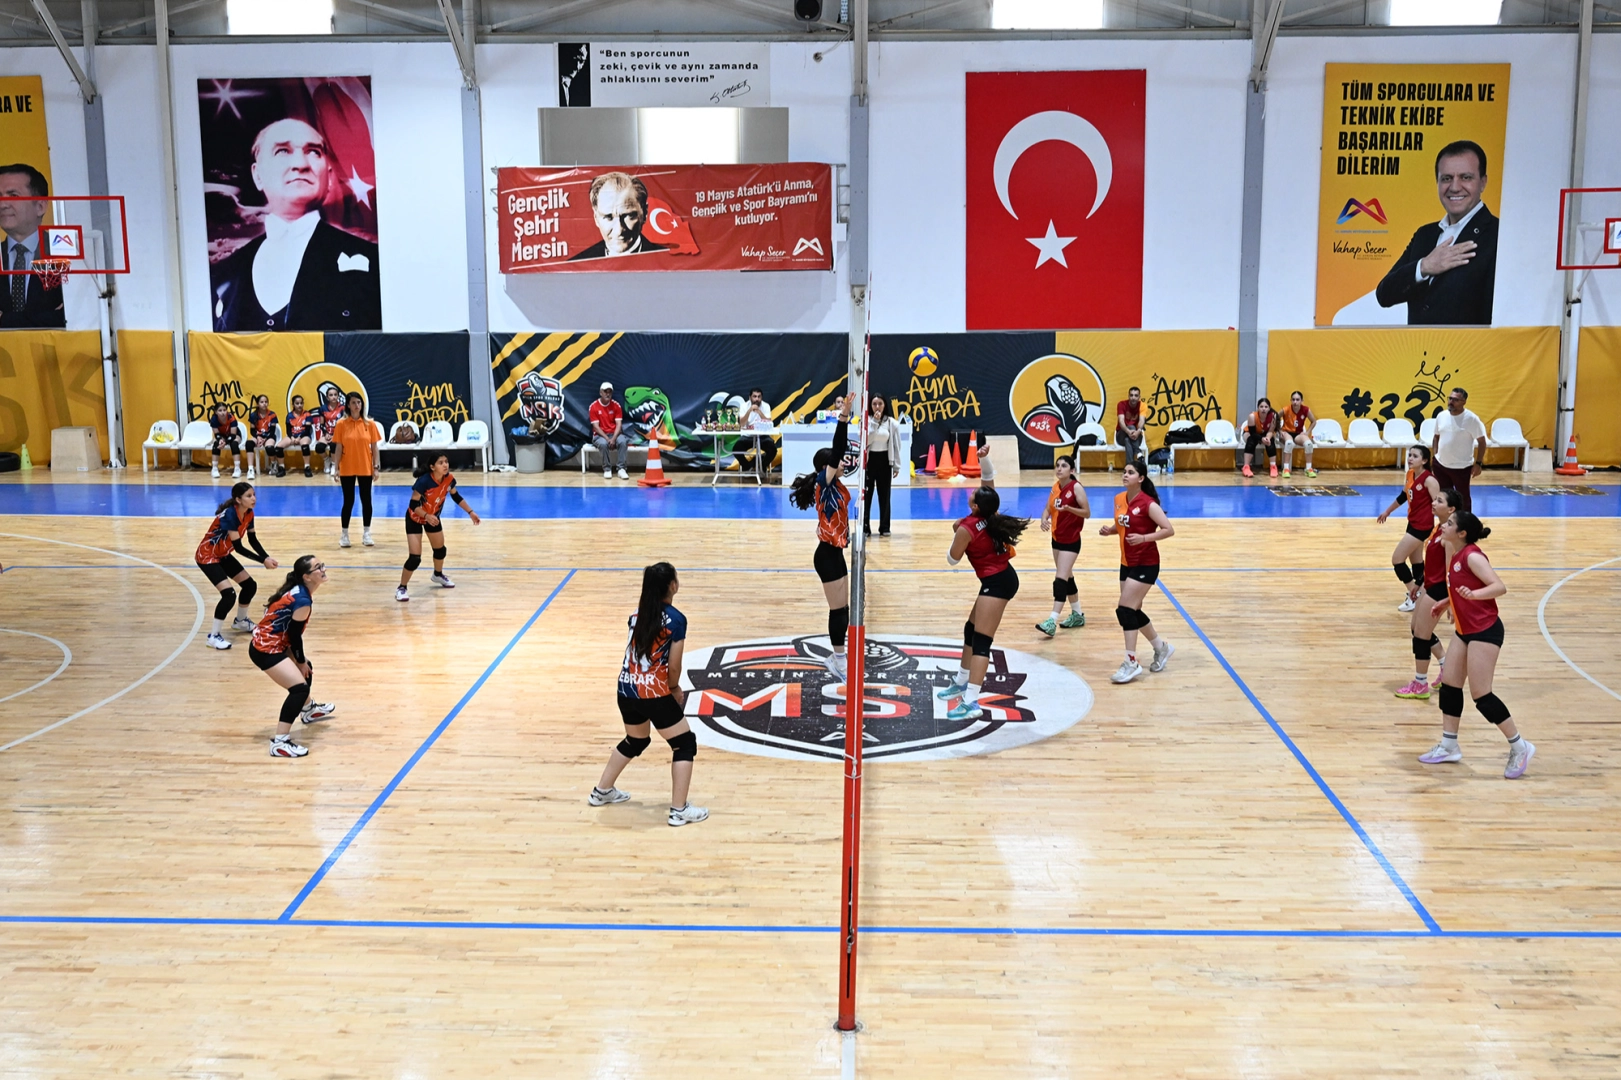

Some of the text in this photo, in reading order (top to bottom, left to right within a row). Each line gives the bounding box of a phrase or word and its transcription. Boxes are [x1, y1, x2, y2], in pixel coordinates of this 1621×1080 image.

[630, 50, 690, 59] sporcunun
[600, 63, 627, 72] zeki,
[631, 63, 661, 72] çevik
[681, 64, 704, 72] aynı
[709, 62, 759, 70] zamanda
[600, 75, 661, 83] ahlaklısını
[1341, 80, 1495, 102] TÜM SPORCULARA VE
[15, 95, 32, 112] VE
[1340, 104, 1445, 126] TEKNİK EKİBE
[1338, 131, 1424, 153] BAŞARILAR
[1337, 153, 1400, 175] DİLERİM
[695, 191, 705, 203] 19
[707, 190, 735, 203] Mayıs
[783, 179, 814, 191] Anma,
[508, 188, 570, 215] Gençlik
[691, 203, 727, 218] Gençlik
[730, 203, 741, 213] ve
[743, 198, 766, 213] Spor
[513, 212, 559, 241] Şehri
[735, 212, 778, 226] kutluyor.
[512, 237, 568, 262] Mersin
[741, 245, 766, 261] Vahap
[1333, 240, 1362, 259] Vahap
[522, 401, 562, 420] MSK
[1117, 514, 1130, 528] 22
[618, 671, 655, 685] EBRAR
